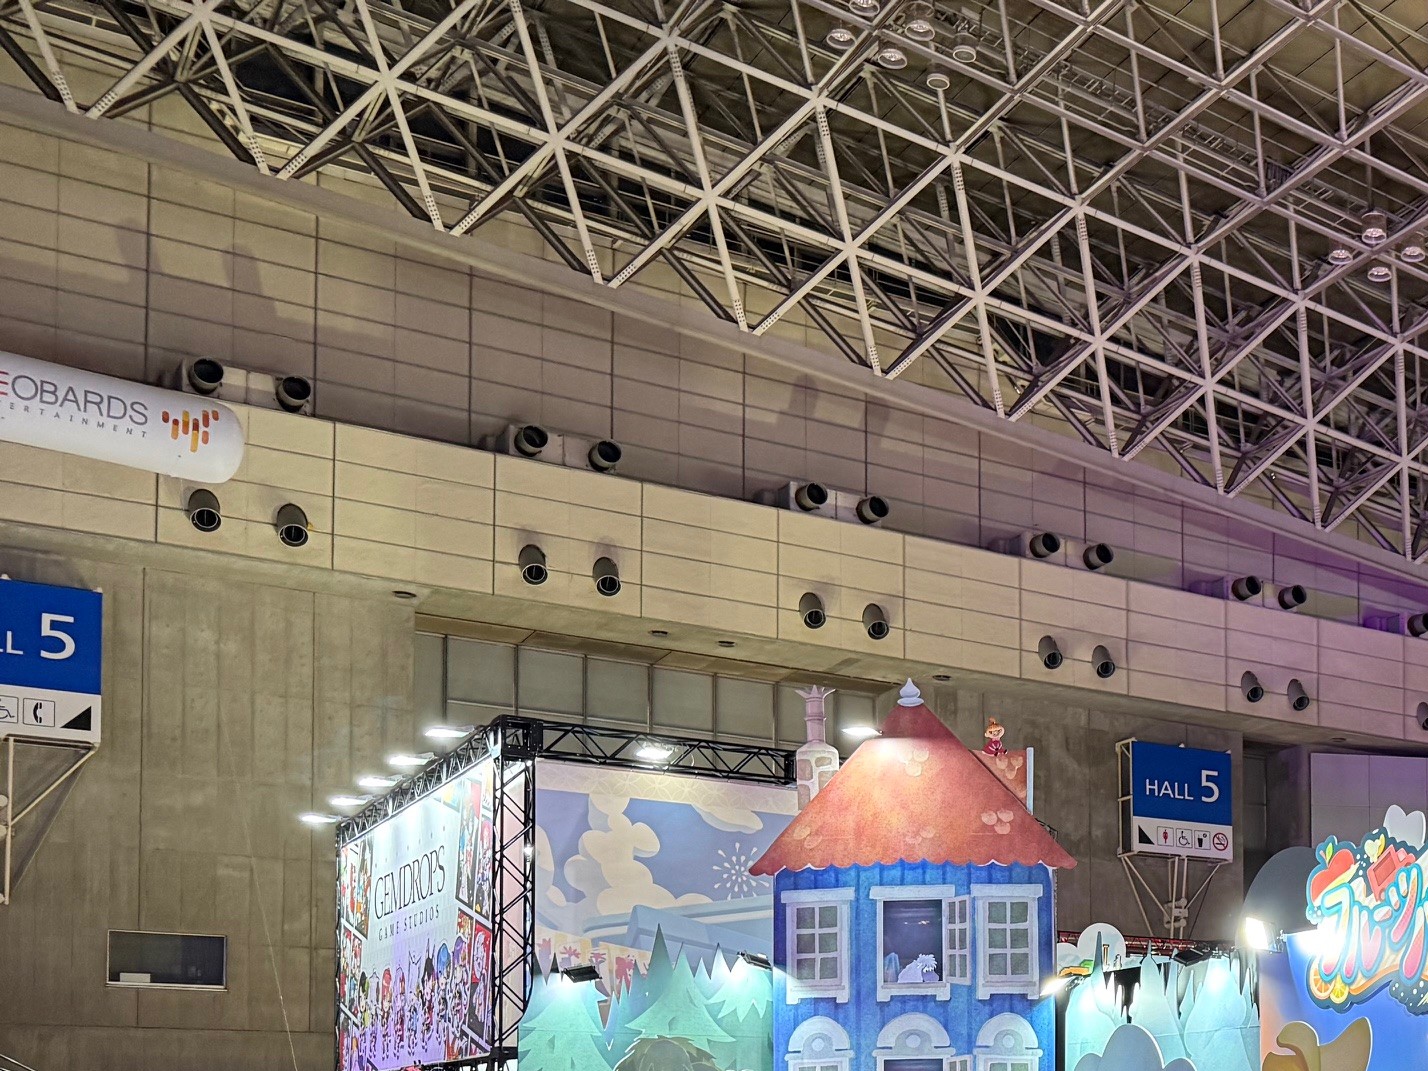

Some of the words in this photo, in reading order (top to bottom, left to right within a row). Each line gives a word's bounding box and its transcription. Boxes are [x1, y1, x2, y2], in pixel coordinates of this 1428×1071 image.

[0, 630, 24, 655] L
[40, 612, 76, 660] 5
[1145, 778, 1194, 800] HALL
[1201, 769, 1220, 803] 5
[375, 845, 446, 919] GEMDROPS
[379, 920, 400, 941] GAME
[403, 904, 440, 931] STUDIOS
